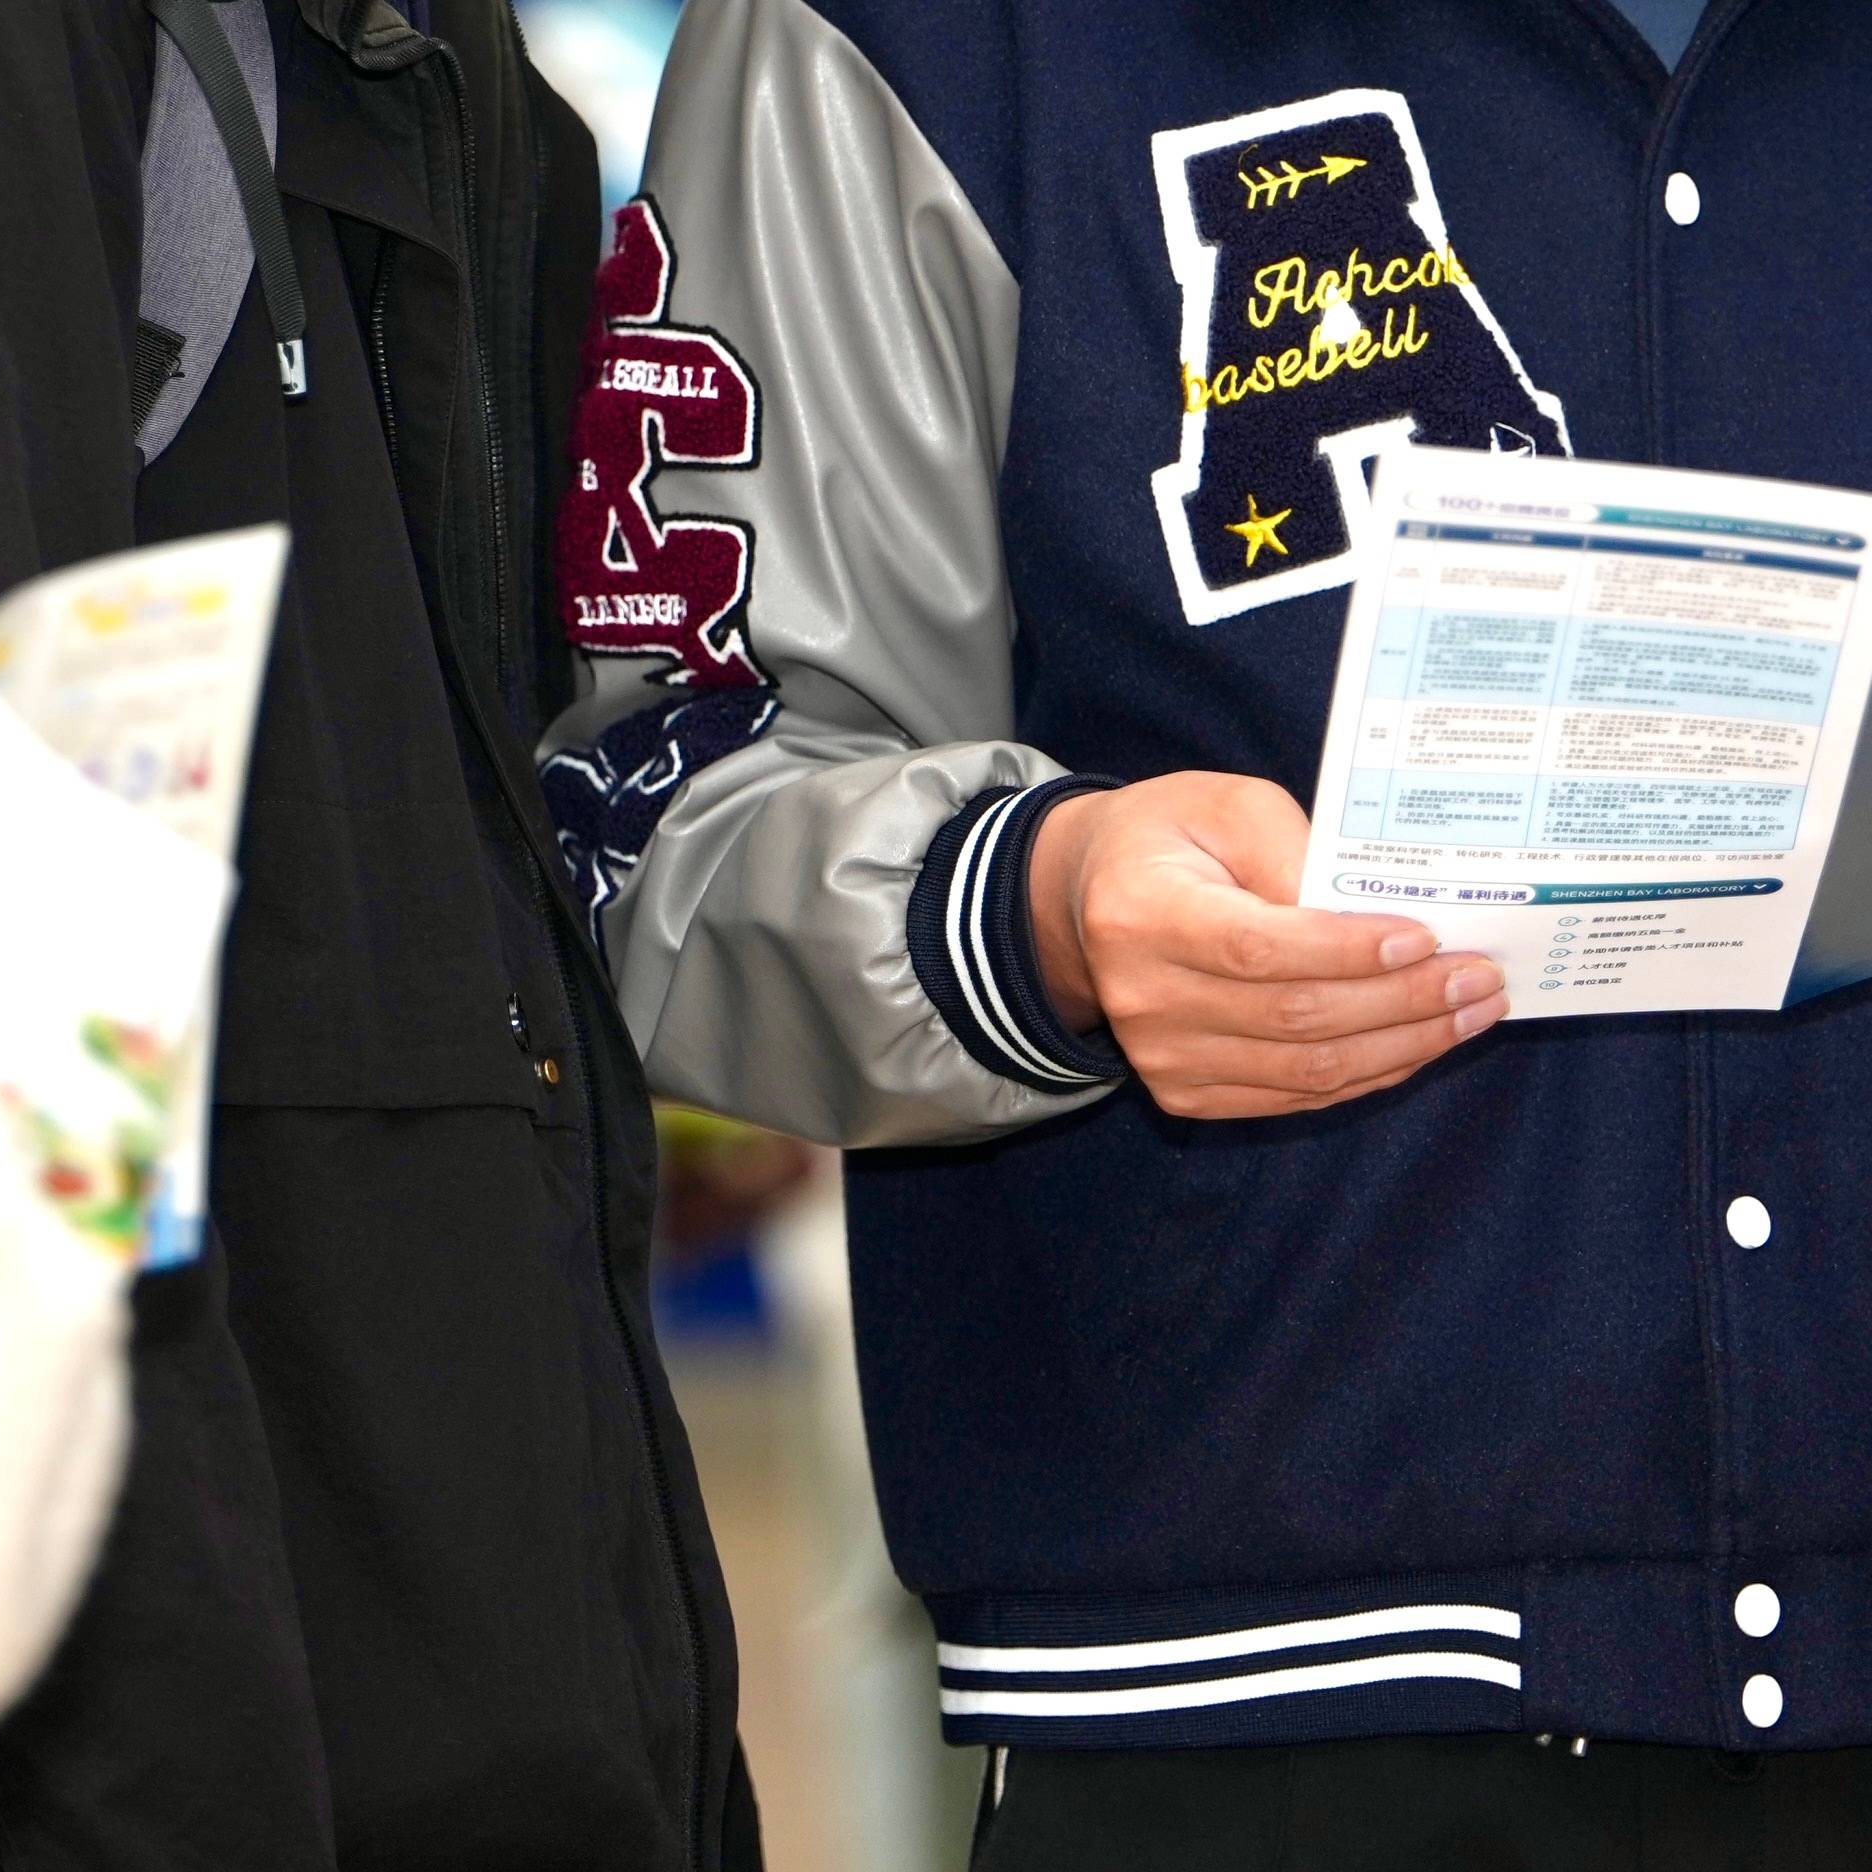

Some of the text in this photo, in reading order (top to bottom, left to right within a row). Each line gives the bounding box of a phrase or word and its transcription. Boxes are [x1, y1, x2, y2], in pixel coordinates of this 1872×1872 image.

[1457, 888, 1528, 901] 福利待遇
[1551, 884, 1747, 899] SHENZHEN BAY LABORATORY
